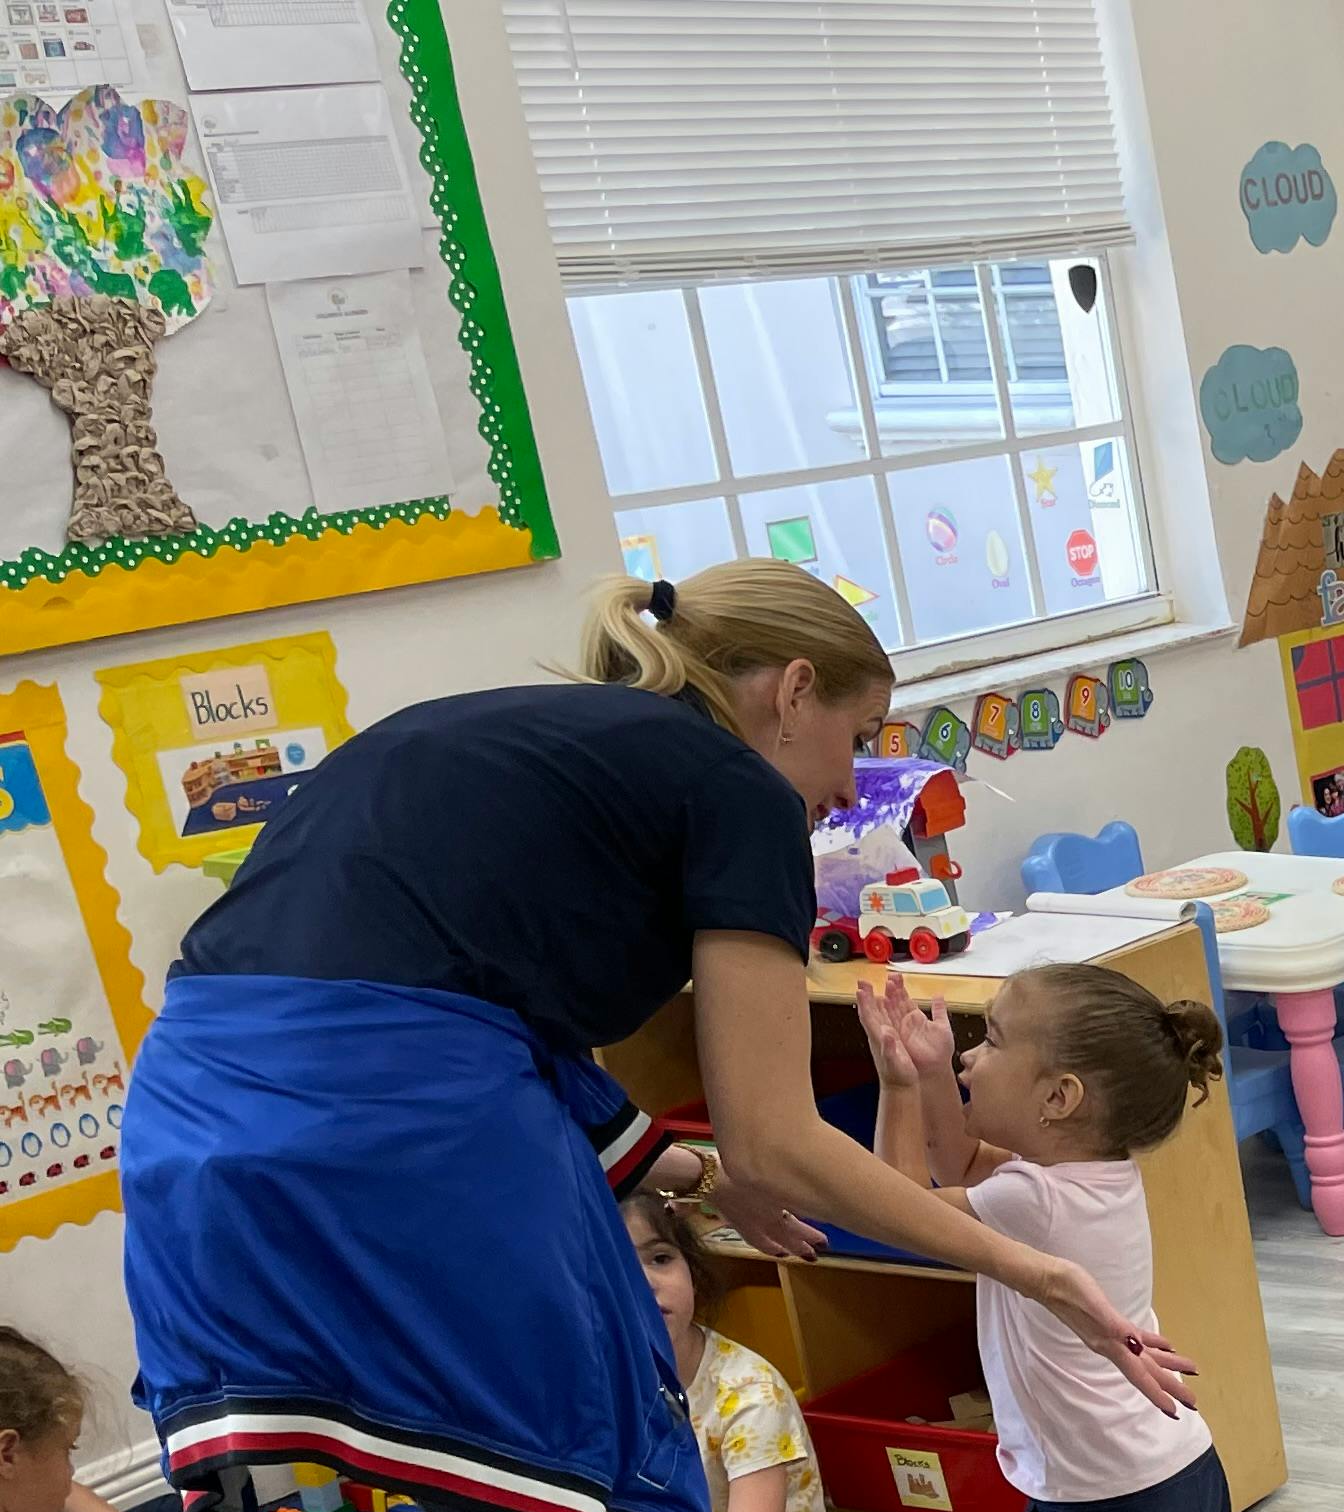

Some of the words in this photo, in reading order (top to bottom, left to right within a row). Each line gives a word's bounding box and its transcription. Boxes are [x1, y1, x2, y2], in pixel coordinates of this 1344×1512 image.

[1243, 169, 1325, 210] CLOUD
[1213, 374, 1297, 422] CLOUD
[1069, 542, 1095, 561] STOP
[1118, 670, 1135, 690] 10
[1081, 687, 1091, 705] 9
[190, 689, 270, 728] Blocks
[989, 705, 1000, 724] 7
[1030, 701, 1041, 720] 8
[939, 721, 952, 742] 6
[890, 734, 900, 754] 5
